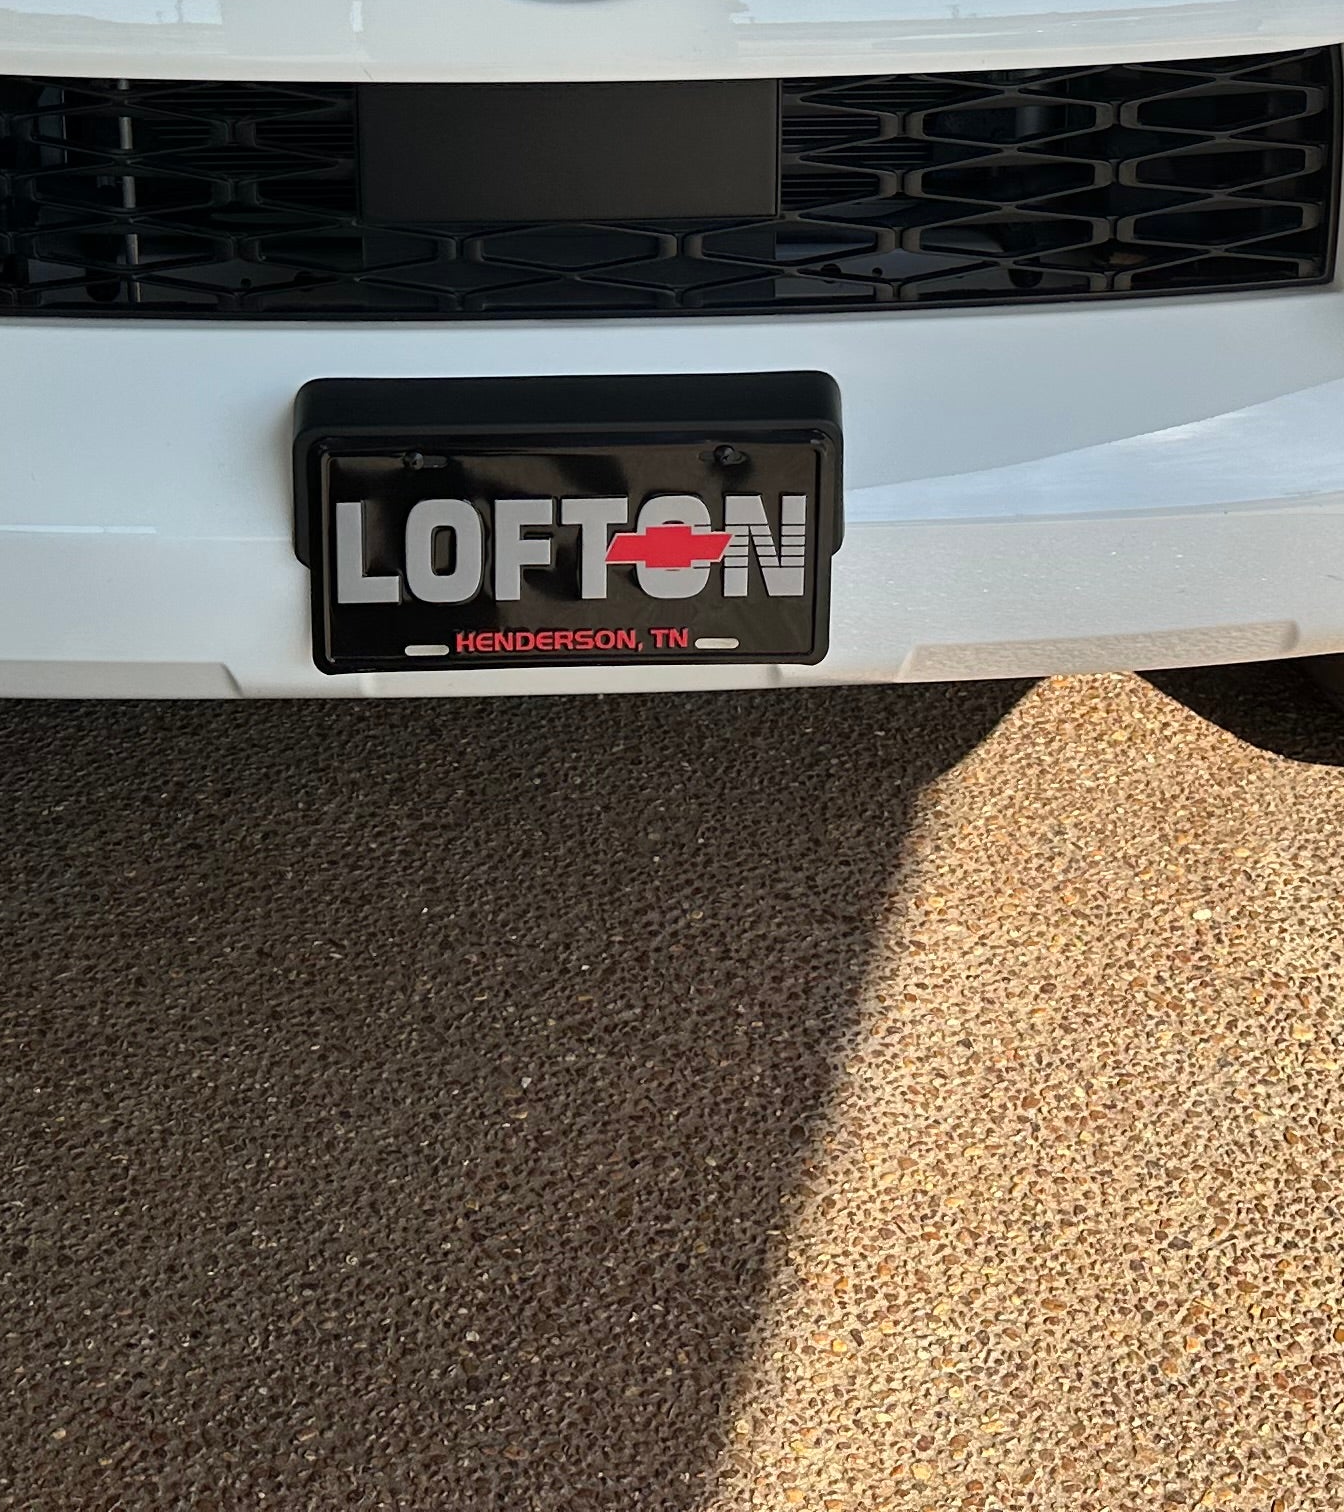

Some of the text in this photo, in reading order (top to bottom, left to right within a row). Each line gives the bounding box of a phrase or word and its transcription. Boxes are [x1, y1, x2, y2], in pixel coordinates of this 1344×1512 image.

[335, 494, 808, 605] LOFTON
[456, 628, 689, 653] HENDERSON, TN
